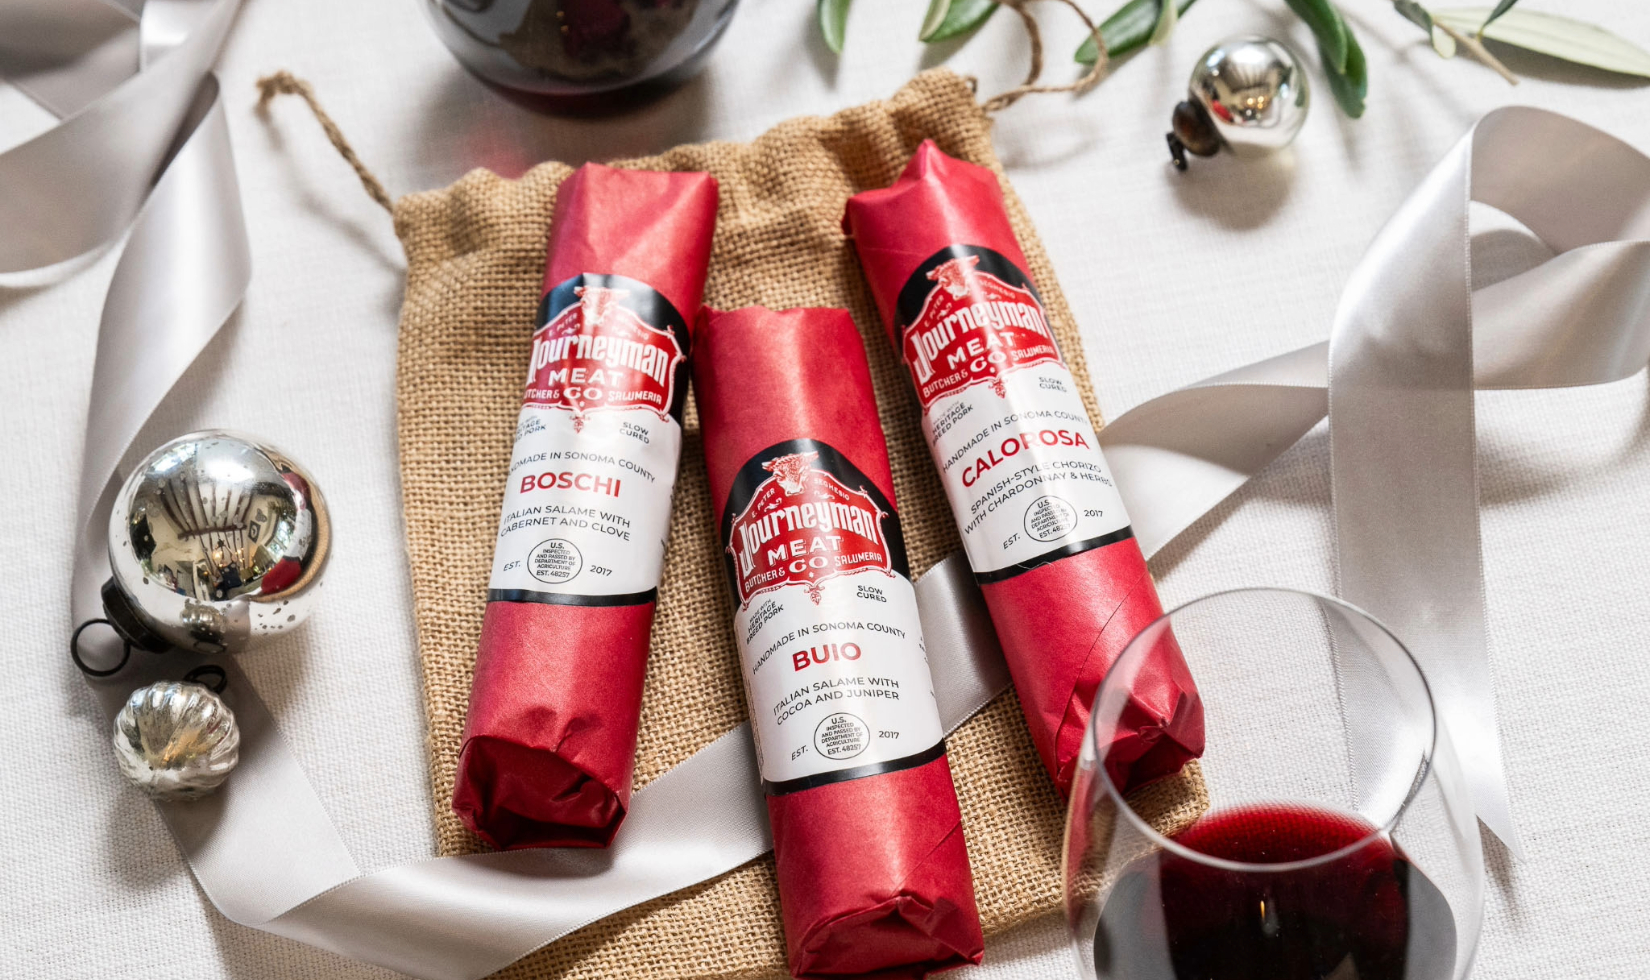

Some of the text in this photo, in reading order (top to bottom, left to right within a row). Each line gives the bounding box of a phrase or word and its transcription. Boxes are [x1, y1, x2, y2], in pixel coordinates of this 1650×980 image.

[910, 300, 1049, 386] Journeyman
[946, 332, 1015, 370] MEAT
[548, 367, 623, 387] MEAT
[922, 373, 961, 398] BUTCHER
[961, 369, 968, 378] &
[1011, 345, 1056, 361] SALUMERIA
[1039, 376, 1062, 385] SLOW
[523, 388, 553, 400] UTCHER
[553, 389, 560, 399] &
[608, 390, 662, 405] SALUMERIA
[932, 402, 966, 434] HERITAGE
[952, 404, 974, 424] PORK
[619, 428, 650, 445] CURED
[623, 421, 649, 435] SLOW
[942, 428, 994, 474] HANDMADE
[991, 420, 1002, 432] IN
[1004, 410, 1053, 425] SONOMA
[550, 451, 561, 460] IN
[564, 451, 615, 465] SONOMA
[618, 459, 656, 483] COUNTY
[961, 430, 1090, 488] CALOROSA
[520, 471, 621, 497] BOSCHI
[814, 478, 850, 501] SEGHESIO
[971, 460, 1102, 515] SPANISH-STYLE CHORIZO
[757, 488, 776, 511] PETER
[964, 471, 1113, 535] WITH CHARDONNAY & HERBS
[503, 505, 631, 528] ITALIAN SALAME WITH
[1084, 509, 1103, 518] 2017
[500, 516, 631, 542] CABERNET AND CLOVE
[1039, 529, 1053, 539] EST.
[738, 501, 880, 581] Journeyman
[768, 535, 842, 567] MEAT
[1003, 532, 1021, 550] EST.
[503, 560, 521, 572] EST.
[536, 569, 571, 578] EST. 48257
[590, 565, 613, 577] 2017
[744, 570, 779, 593] BUTCHER
[778, 568, 786, 577] &
[834, 552, 883, 567] SALUMERIA
[856, 592, 887, 603] CURED
[858, 585, 883, 595] SLOW
[748, 601, 777, 633] HERITAGE
[763, 604, 784, 623] PORK
[752, 622, 906, 675] HANDMADE IN SONOMA COUNTY
[792, 642, 862, 672] BUIO
[773, 677, 899, 716] ITALIAN SALAME WITH
[777, 689, 900, 726] COCOA AND JUNIPER
[831, 716, 847, 725] U.S.
[821, 731, 833, 739] AND
[878, 730, 900, 740] 2017
[791, 744, 809, 761] EST.
[827, 746, 842, 755] EST.
